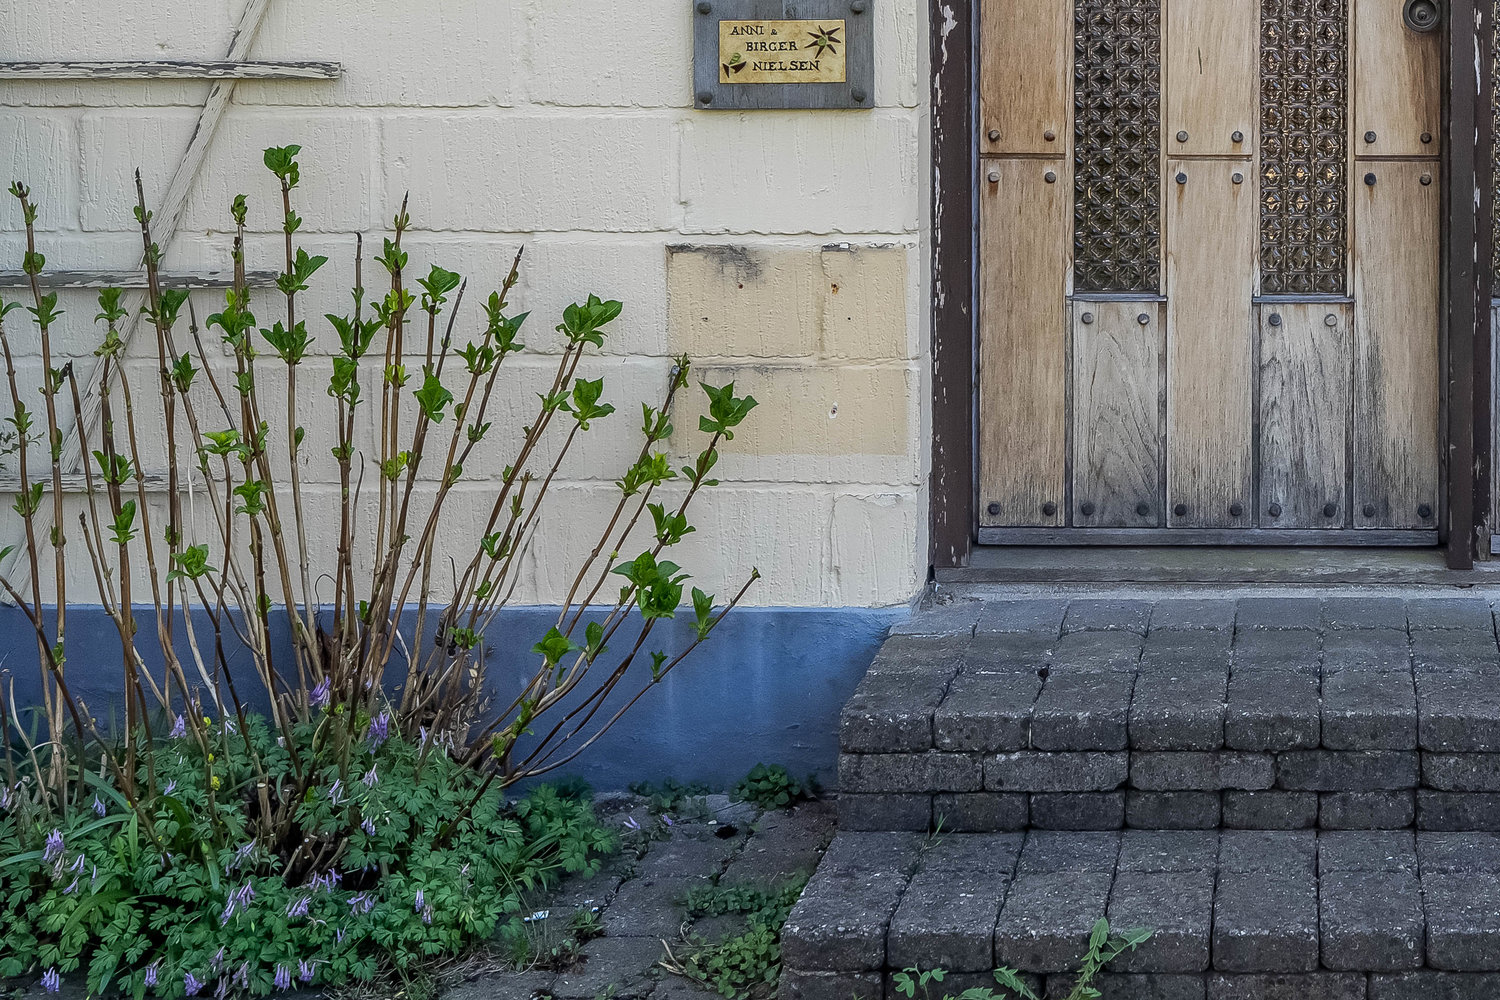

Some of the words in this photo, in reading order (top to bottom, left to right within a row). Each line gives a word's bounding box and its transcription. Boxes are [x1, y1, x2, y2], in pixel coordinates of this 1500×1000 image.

[730, 25, 764, 35] ANNI
[745, 41, 798, 51] BIRGER
[752, 60, 820, 71] NIELSEN
